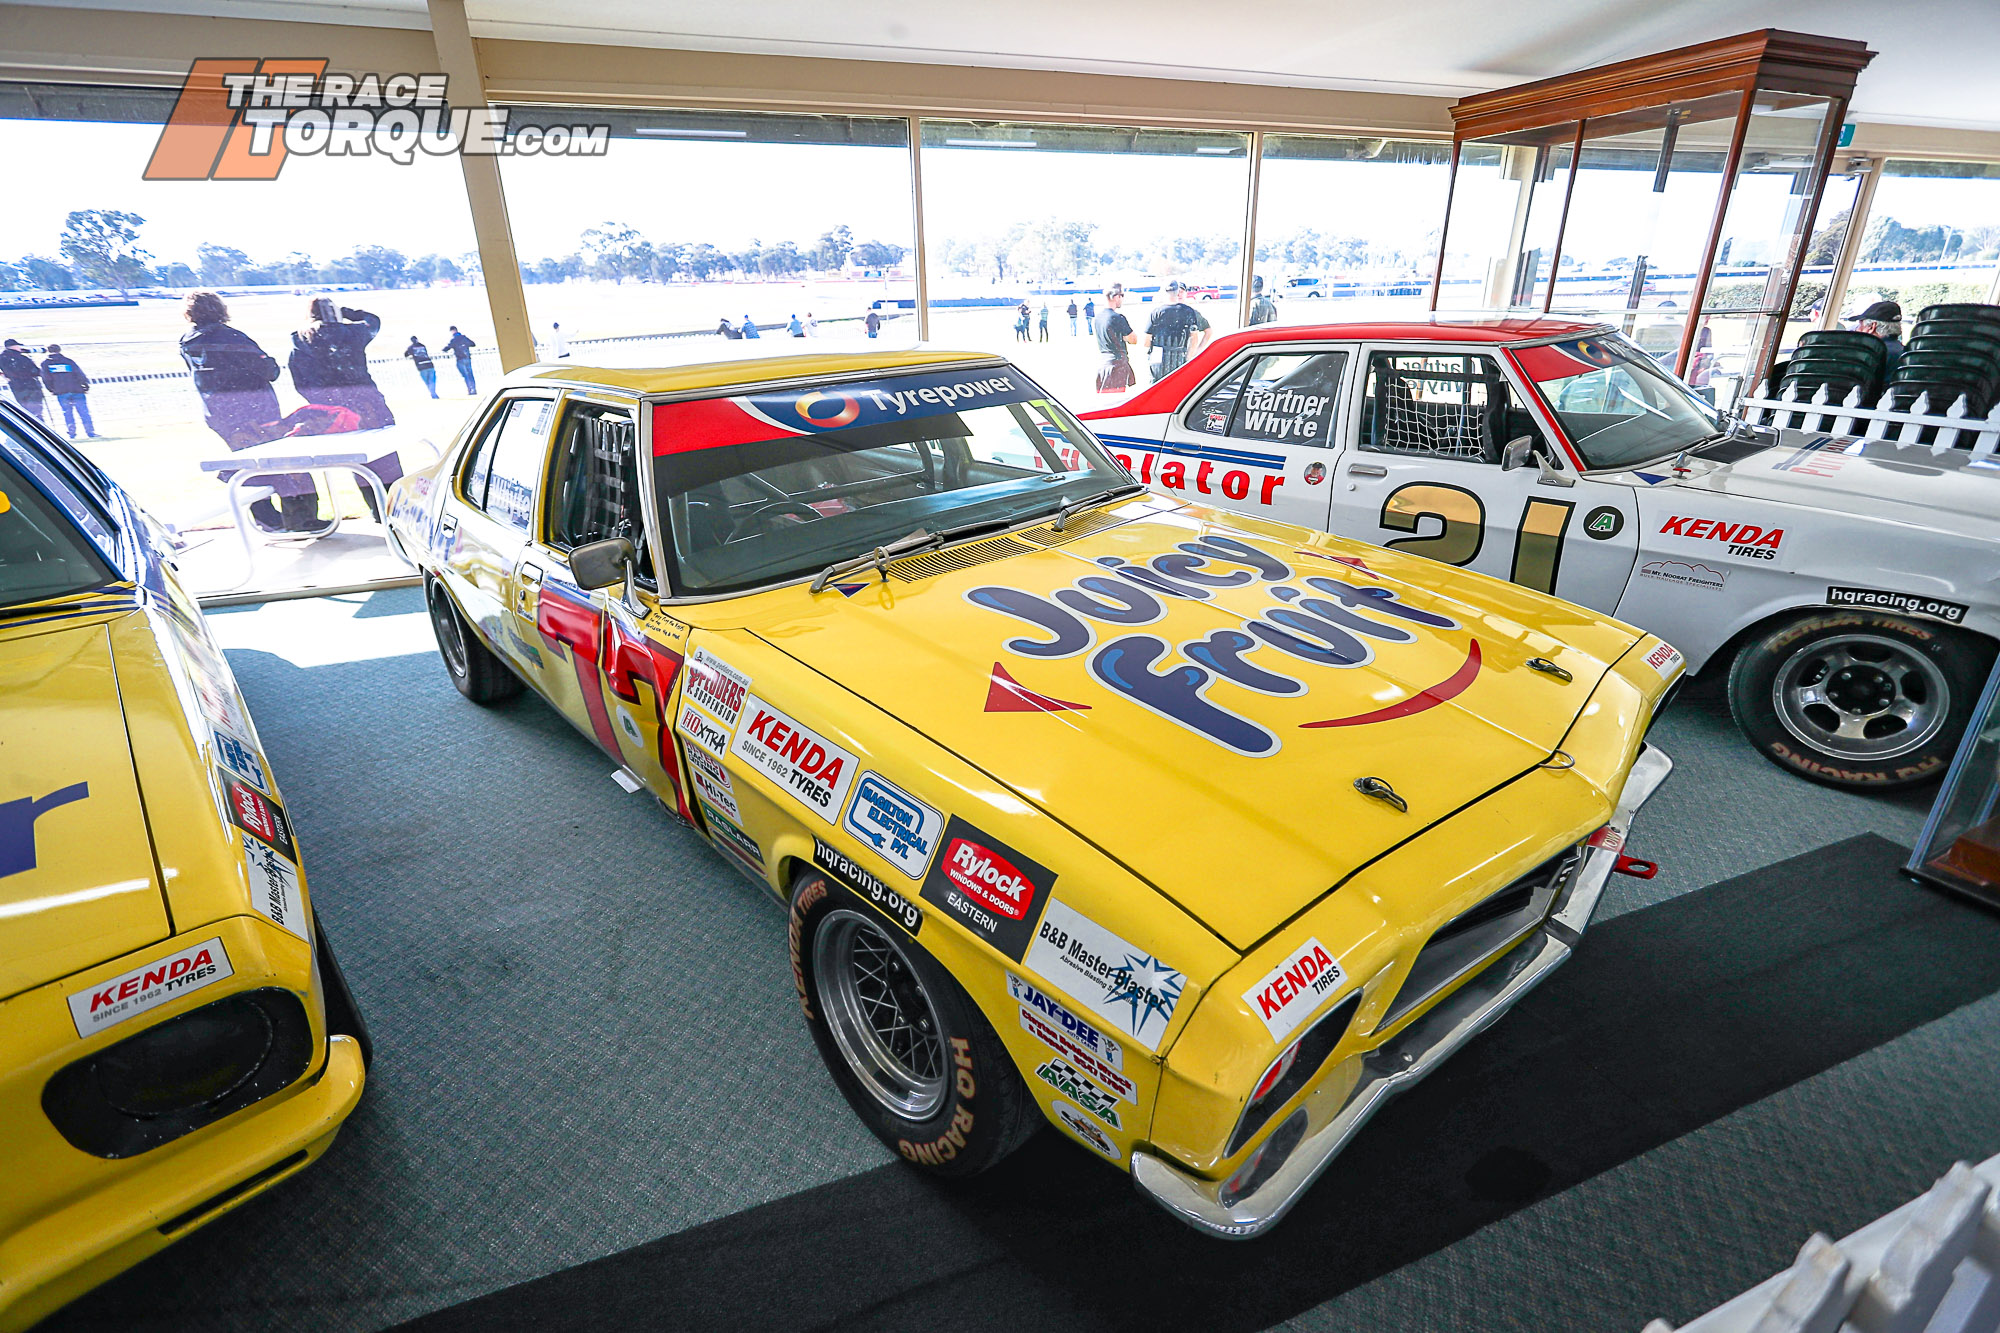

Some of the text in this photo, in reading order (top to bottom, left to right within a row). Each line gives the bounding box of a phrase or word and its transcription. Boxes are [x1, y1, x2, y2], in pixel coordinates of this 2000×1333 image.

[859, 373, 1017, 416] Tyrepower
[1245, 389, 1329, 416] Gartner
[1244, 410, 1318, 438] Whyte
[1379, 481, 1576, 597] 21
[1659, 516, 1784, 549] KENDA
[1728, 545, 1776, 560] TIRES
[961, 535, 1296, 661] Juicy
[1831, 588, 1962, 620] hqracing.org
[1084, 575, 1463, 758] Fruit
[1647, 643, 1676, 670] KENDA
[693, 686, 737, 725] SUSPENSION
[747, 710, 844, 790] KENDA
[742, 741, 832, 808] SINCE 1962 TYRES
[235, 785, 263, 833] Rylock
[861, 786, 914, 828] MAGILTON
[867, 806, 928, 856] ELECTRICAL
[890, 837, 909, 860] P/L
[1601, 830, 1622, 850] TOW
[815, 838, 918, 928] hqracing.org
[949, 868, 983, 895] WINDOWS
[982, 889, 989, 900] &
[952, 843, 1027, 903] Rylock
[797, 879, 828, 916] TIRES
[947, 891, 999, 934] EASTERN
[90, 949, 214, 1013] KENDA
[1039, 921, 1168, 1011] B&B Master Blaster
[1059, 954, 1085, 974] Abrasive
[1083, 969, 1108, 990] Blasting
[1256, 945, 1333, 1021] KENDA
[1311, 965, 1341, 996] TIRES
[92, 964, 218, 1023] SINCE 1962 TYRES
[1023, 986, 1100, 1049] JAY-DEE
[1039, 1066, 1120, 1129] AASA
[898, 1103, 975, 1165] RACING
